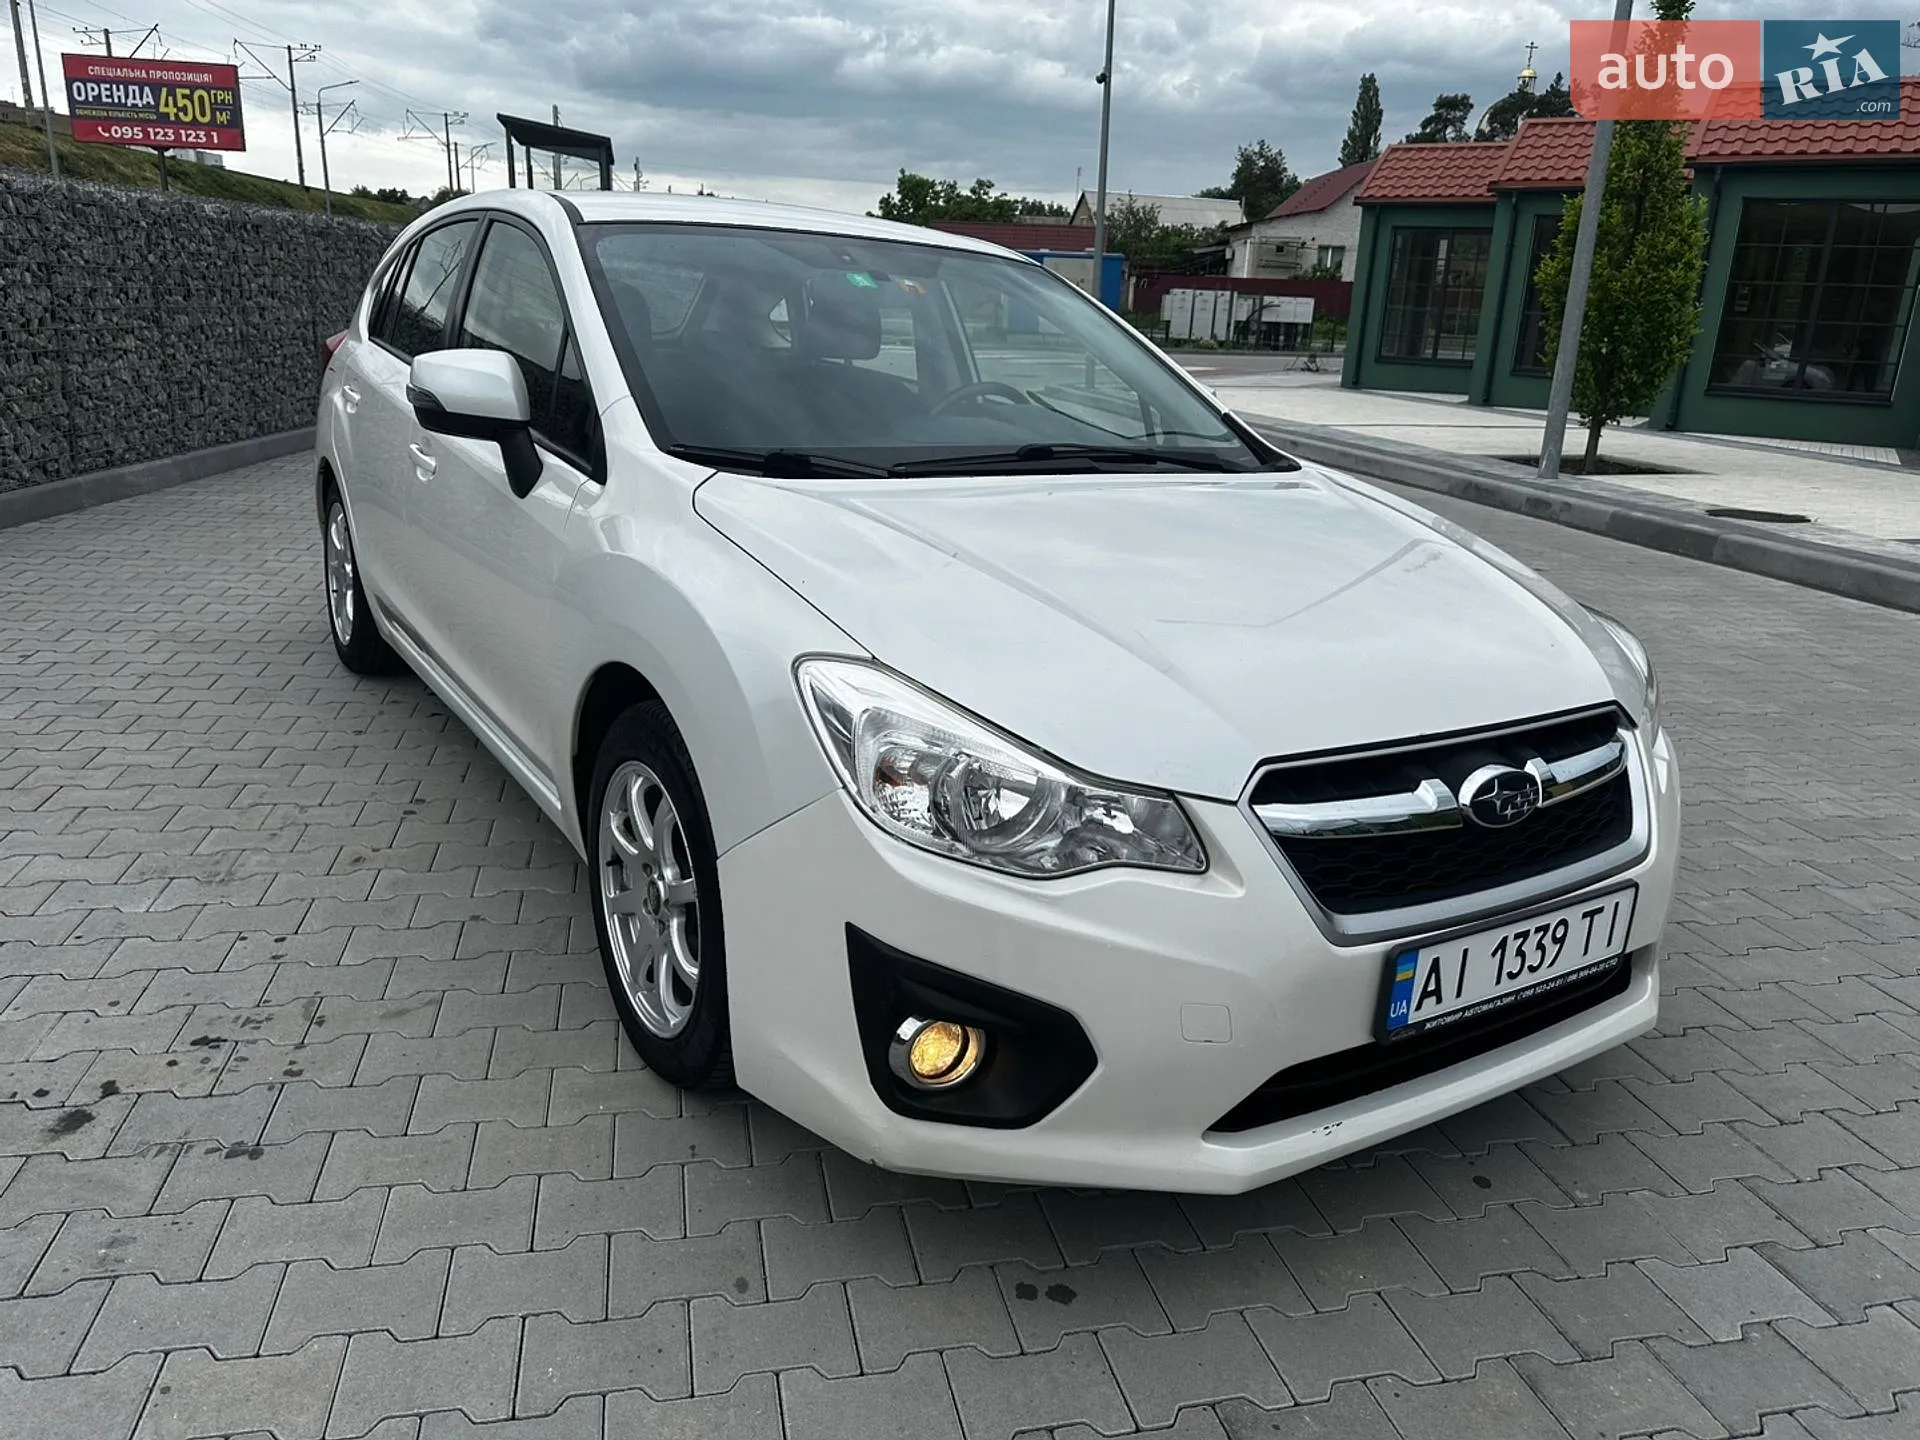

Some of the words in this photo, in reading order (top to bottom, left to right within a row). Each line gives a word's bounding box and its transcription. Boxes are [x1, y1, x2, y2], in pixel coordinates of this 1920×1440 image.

[87, 66, 147, 79] СПЕЦІАЛЬНА
[149, 70, 213, 83] ПРОПОЗИЦІЯ!
[72, 81, 155, 107] ОРЕНДА
[159, 87, 211, 123] 450
[211, 89, 233, 105] ГРН
[110, 125, 143, 139] 095
[147, 127, 175, 141] 123
[179, 129, 207, 143] 123
[210, 131, 218, 144] 1
[1414, 947, 1469, 1012] AI
[1491, 918, 1569, 986] 1339
[1581, 901, 1620, 957] TI
[1389, 1000, 1409, 1018] UA
